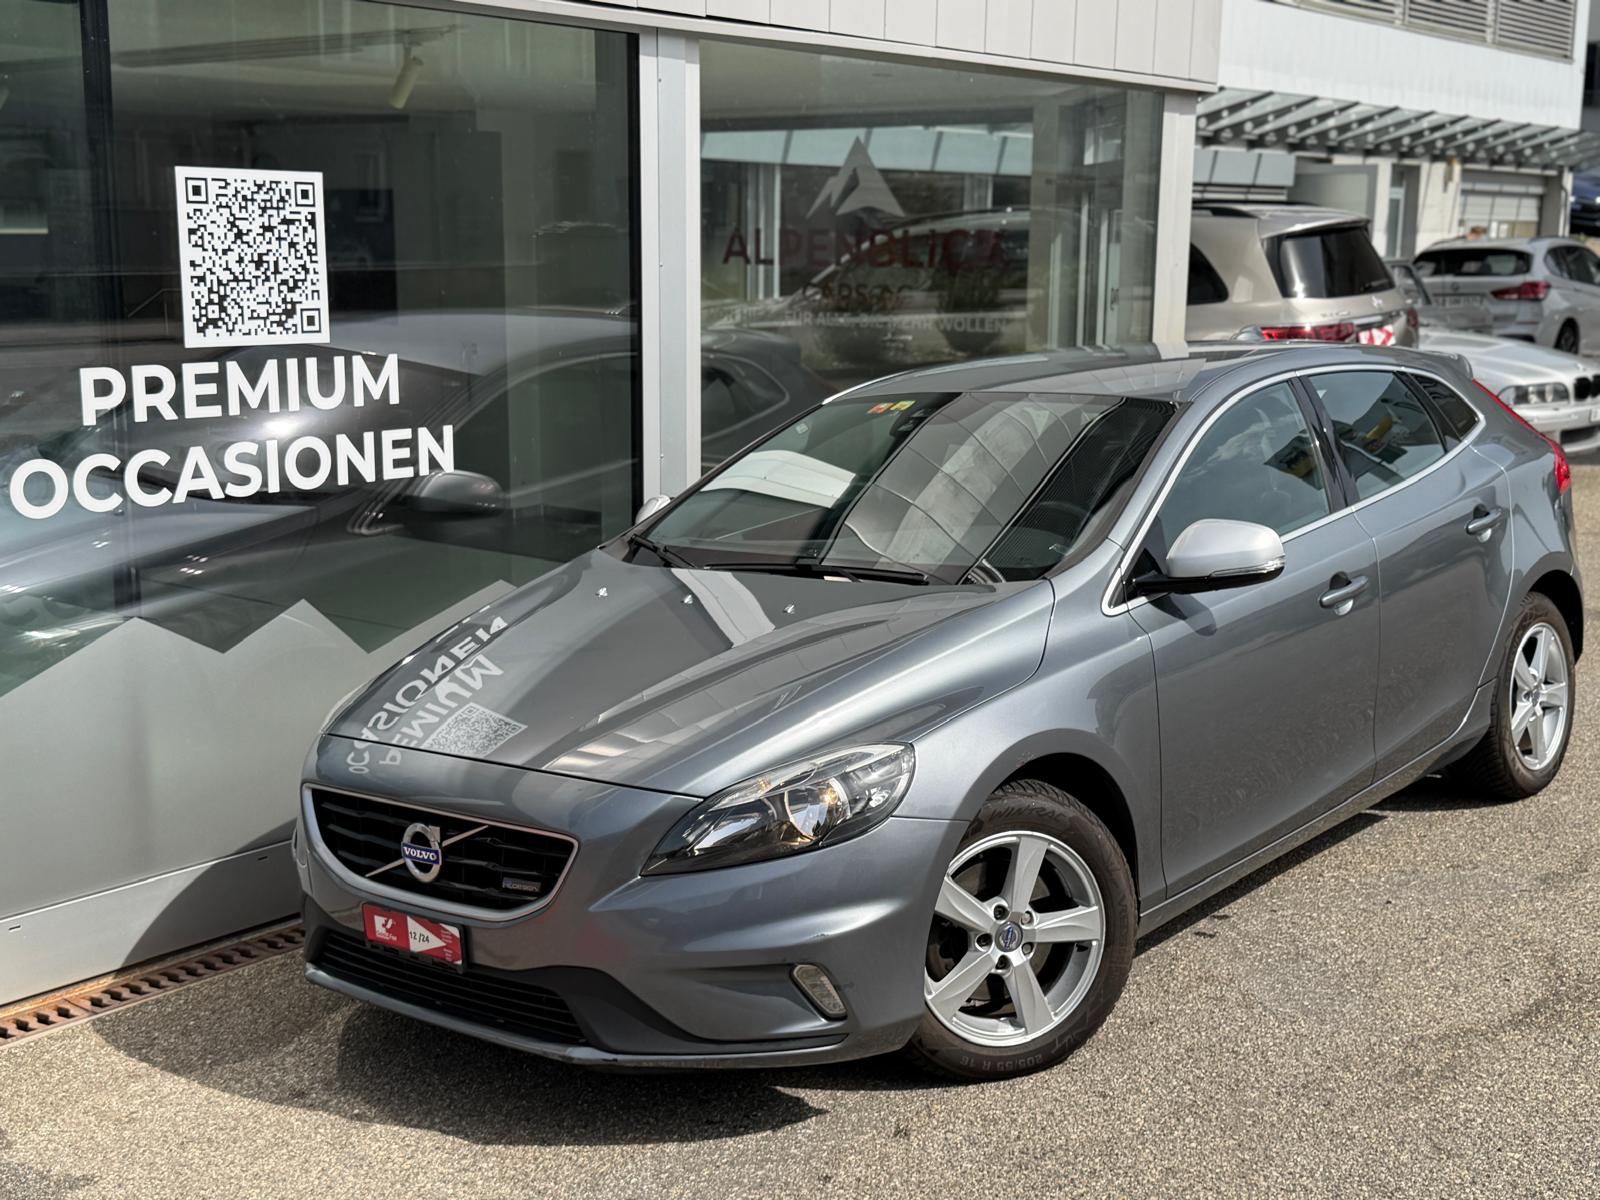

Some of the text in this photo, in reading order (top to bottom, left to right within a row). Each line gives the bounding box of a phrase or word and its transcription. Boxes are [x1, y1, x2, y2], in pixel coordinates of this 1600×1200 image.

[79, 353, 400, 427] PREMIUM
[9, 424, 455, 519] OCCASIONEN
[402, 845, 438, 861] VOLVO
